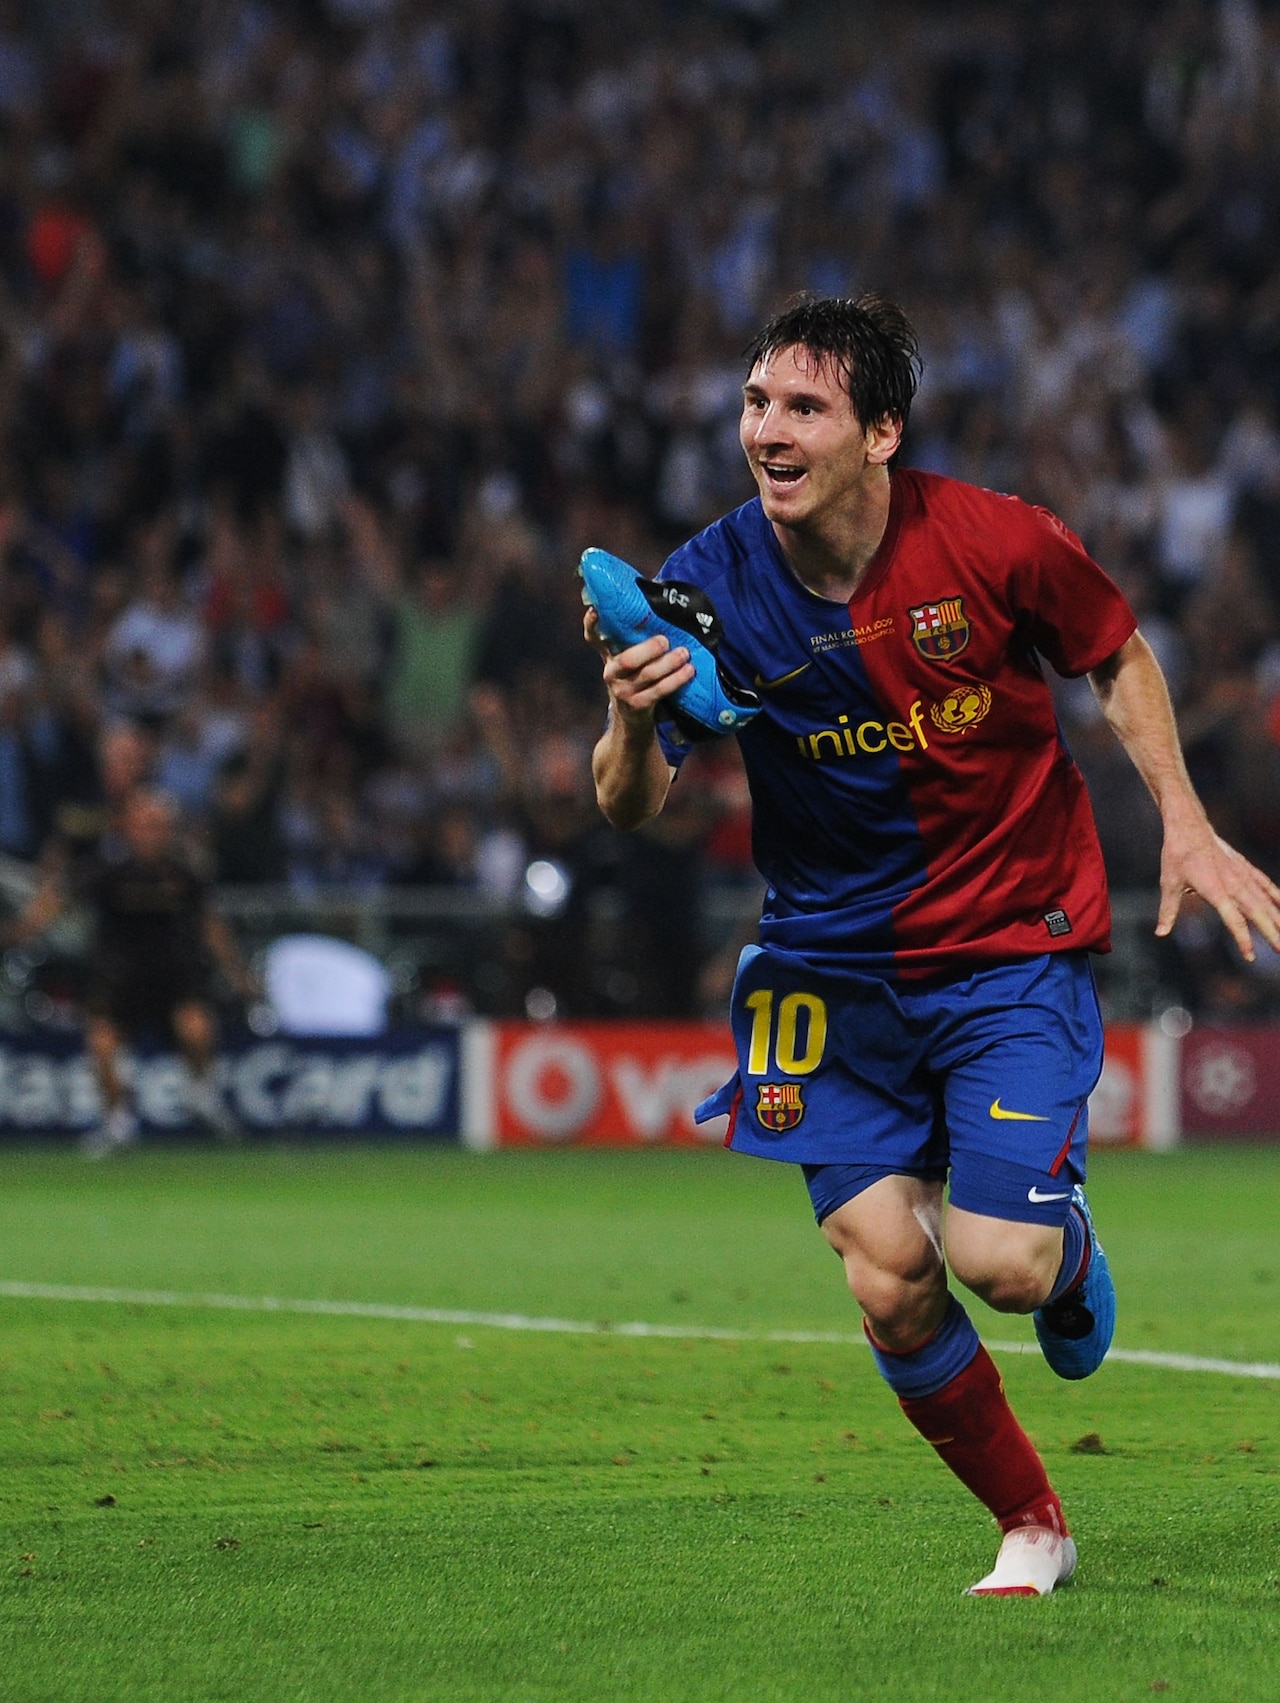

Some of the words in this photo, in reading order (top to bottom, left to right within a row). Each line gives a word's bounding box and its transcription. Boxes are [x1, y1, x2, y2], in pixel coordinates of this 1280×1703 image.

[810, 633, 838, 646] FINAL
[841, 626, 872, 638] ROMA
[745, 990, 827, 1076] 10
